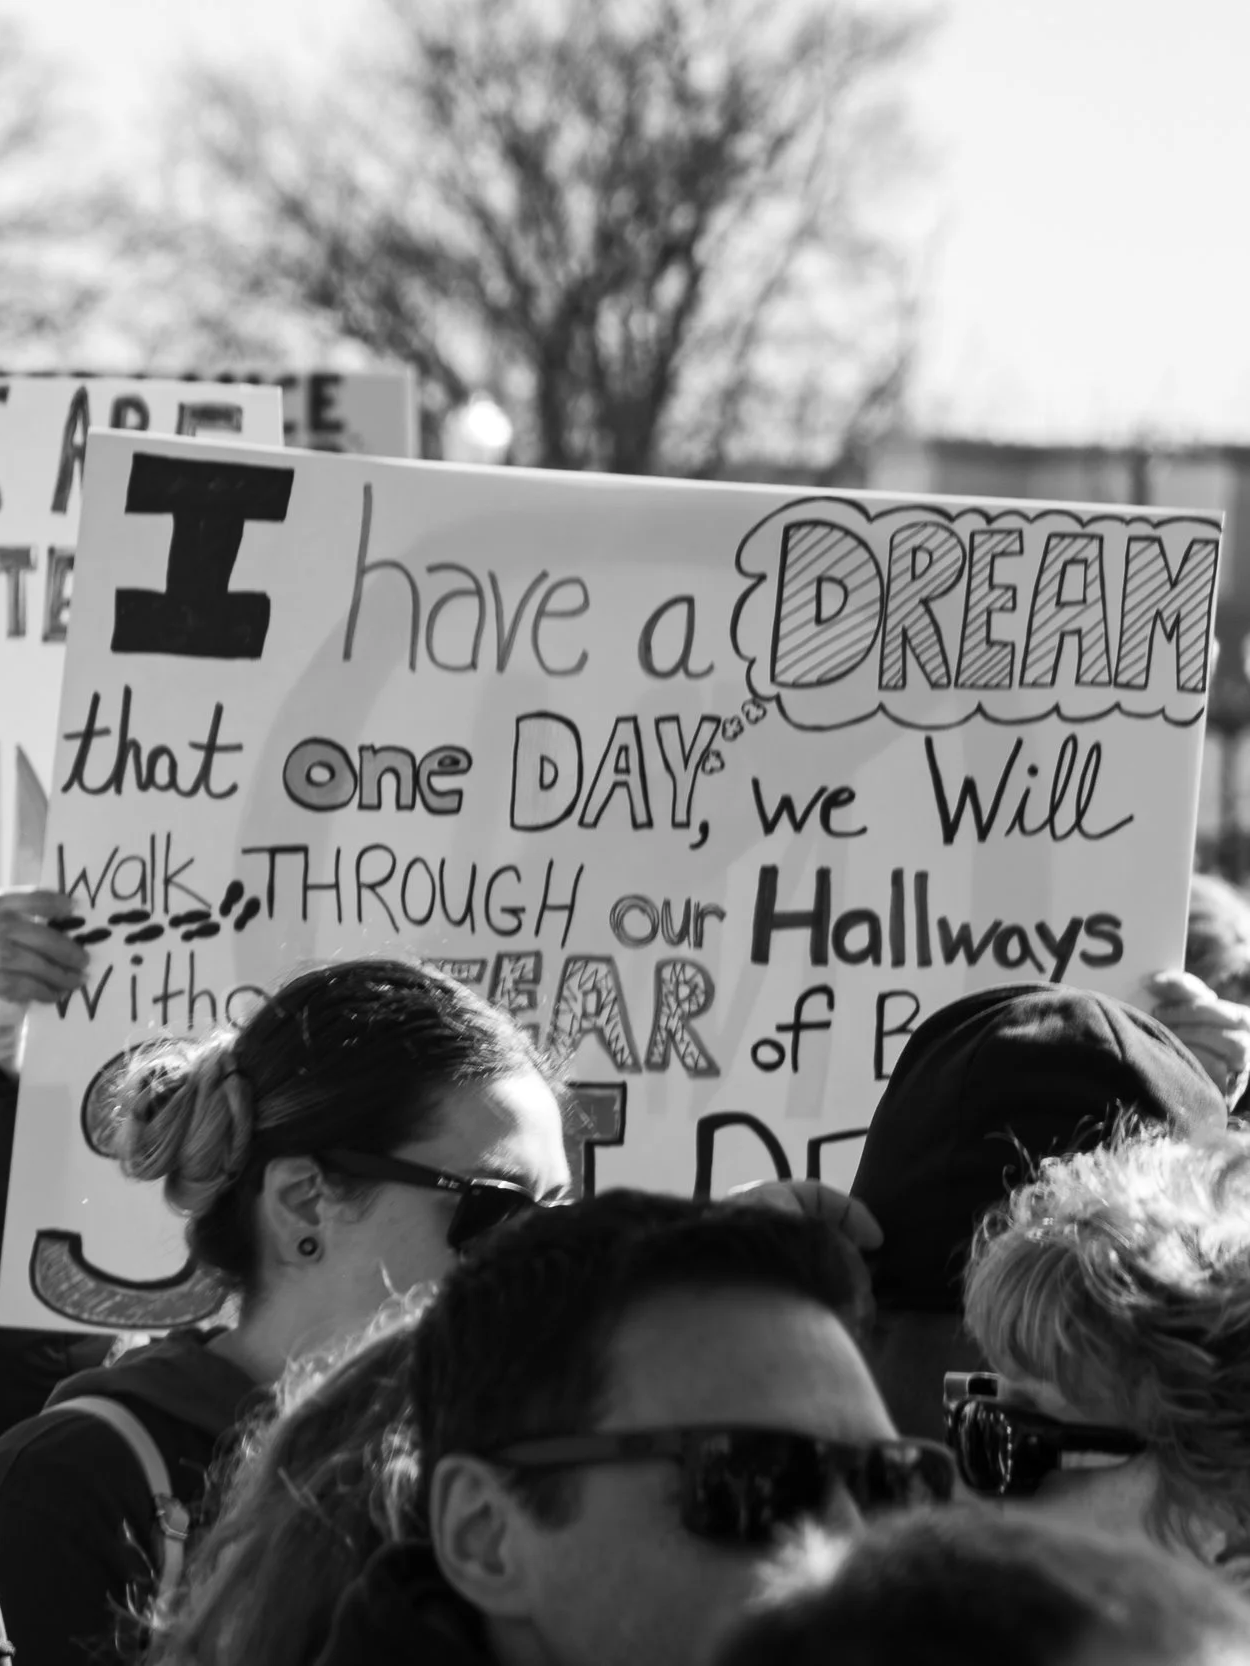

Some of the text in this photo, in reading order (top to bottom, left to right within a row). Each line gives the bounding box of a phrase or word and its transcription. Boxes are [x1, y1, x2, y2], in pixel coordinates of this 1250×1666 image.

[111, 452, 1221, 693] I have a DREAM
[61, 684, 1135, 850] that one DAY, we Will
[241, 842, 584, 949] THROUGH
[609, 893, 726, 950] our
[749, 864, 1125, 983] Hallways
[750, 983, 835, 1073] of
